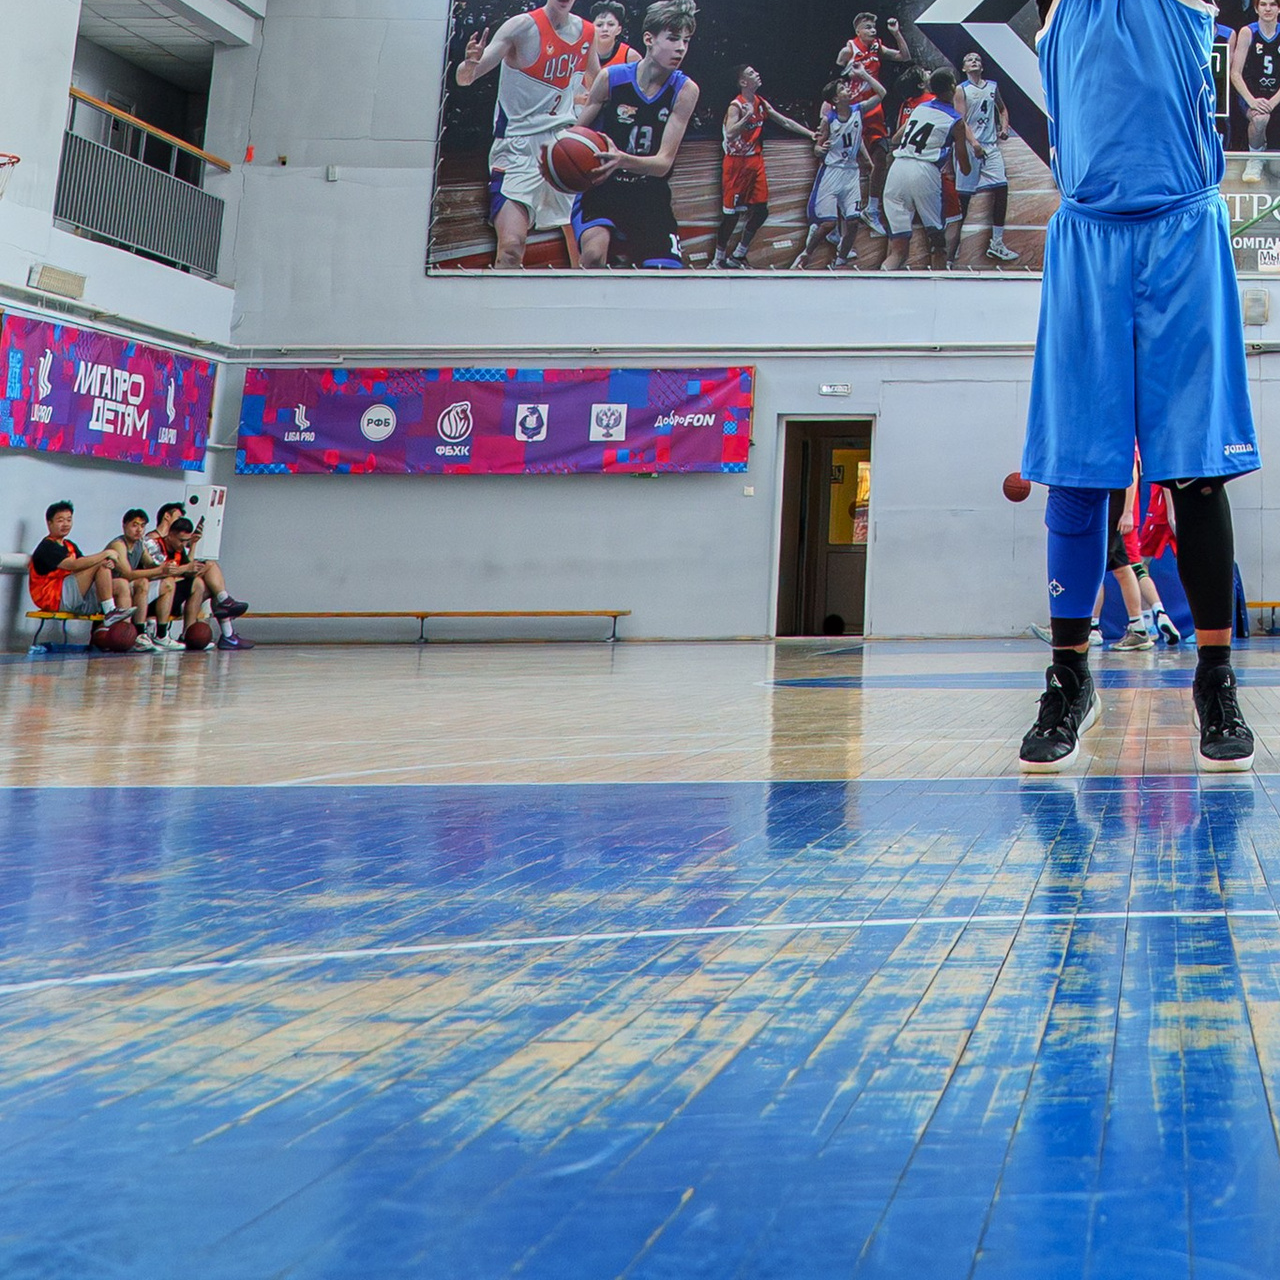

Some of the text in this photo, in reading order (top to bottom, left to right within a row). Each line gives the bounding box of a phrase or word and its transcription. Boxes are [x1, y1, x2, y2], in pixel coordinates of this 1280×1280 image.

[544, 54, 577, 80] ЦСК
[1263, 55, 1273, 75] 5
[548, 94, 562, 116] 2
[980, 99, 988, 114] 4
[900, 119, 935, 155] 14
[89, 398, 149, 440] ДЕТЯМ
[366, 418, 391, 428] РФБ
[301, 432, 315, 442] PRO
[435, 446, 470, 456] ФБХК
[1224, 443, 1254, 456] Joma
